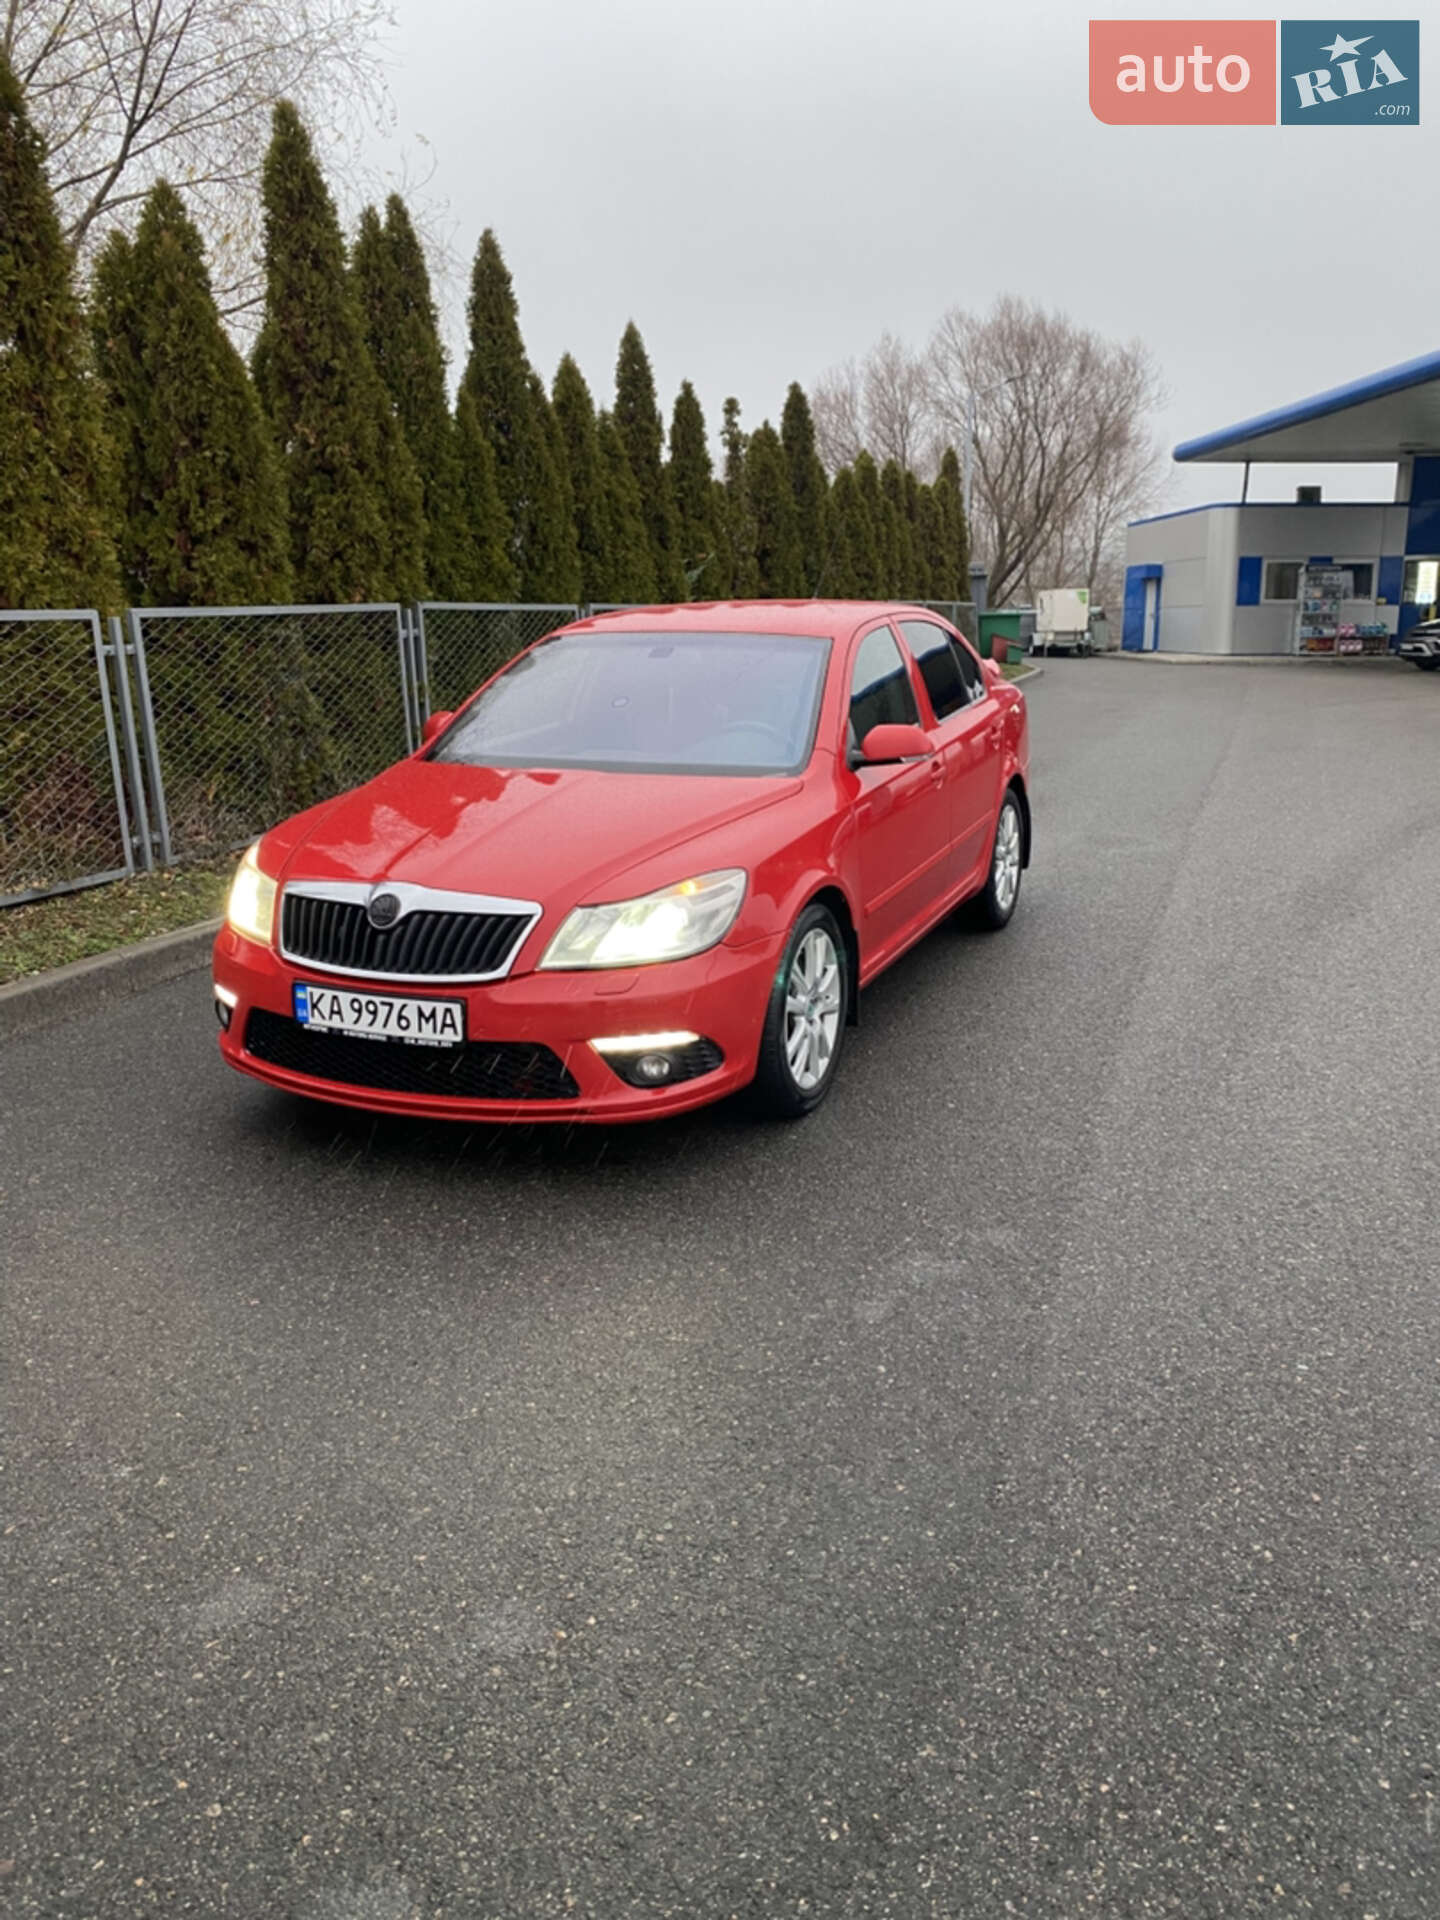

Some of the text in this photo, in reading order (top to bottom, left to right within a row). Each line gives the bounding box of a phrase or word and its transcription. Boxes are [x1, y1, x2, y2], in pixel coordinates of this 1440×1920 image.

[309, 991, 459, 1035] KA 9976 MA
